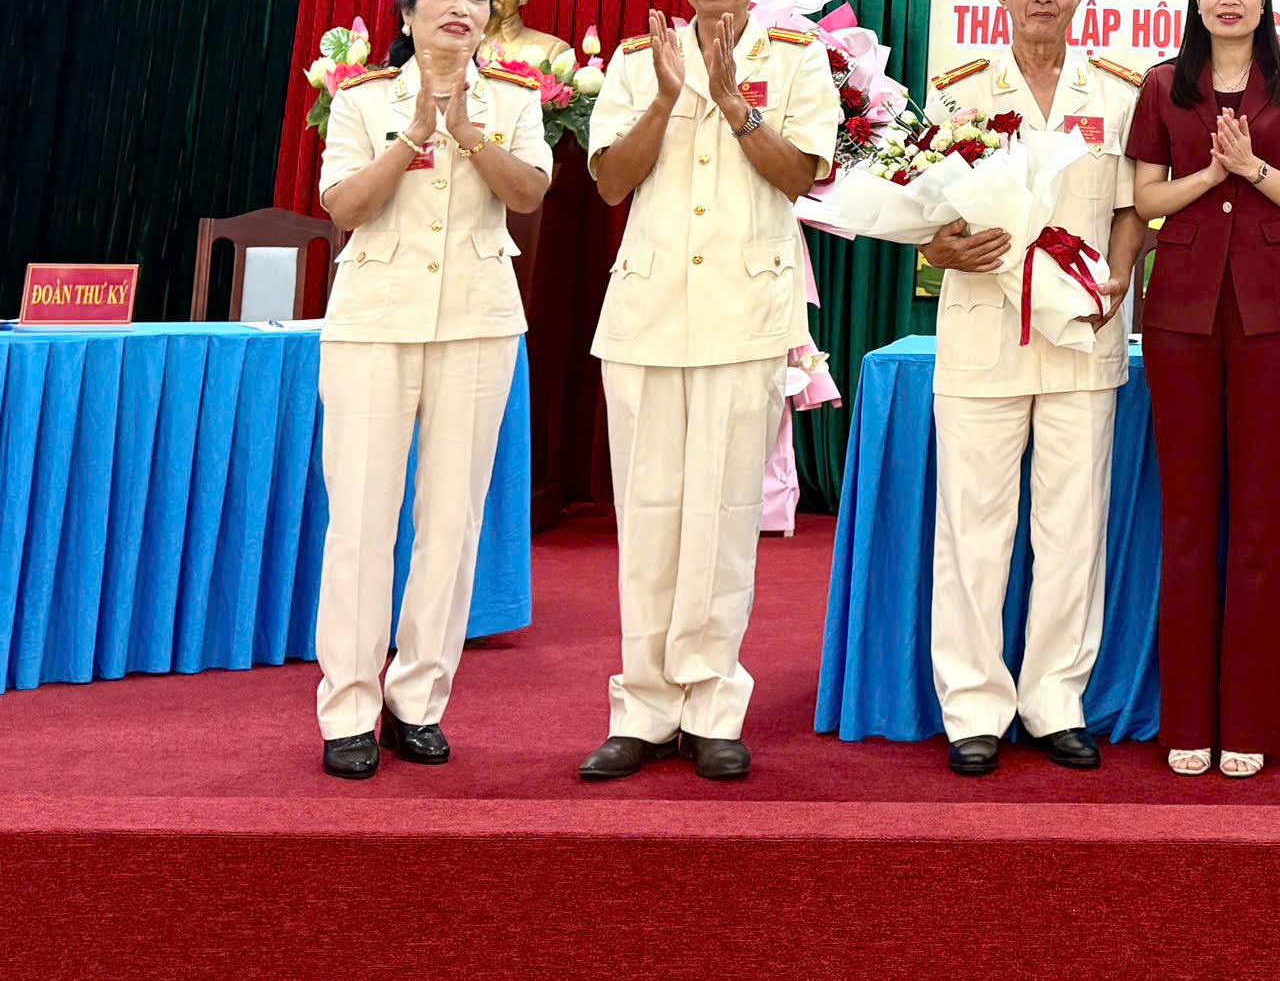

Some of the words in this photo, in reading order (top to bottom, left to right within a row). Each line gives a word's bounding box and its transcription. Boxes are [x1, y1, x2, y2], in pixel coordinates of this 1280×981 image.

[1066, 0, 1121, 56] LẬP
[1131, 1, 1182, 57] HỘI
[31, 278, 73, 305] ĐOÀN
[75, 282, 107, 305] THƯ
[107, 279, 129, 305] KÝ
